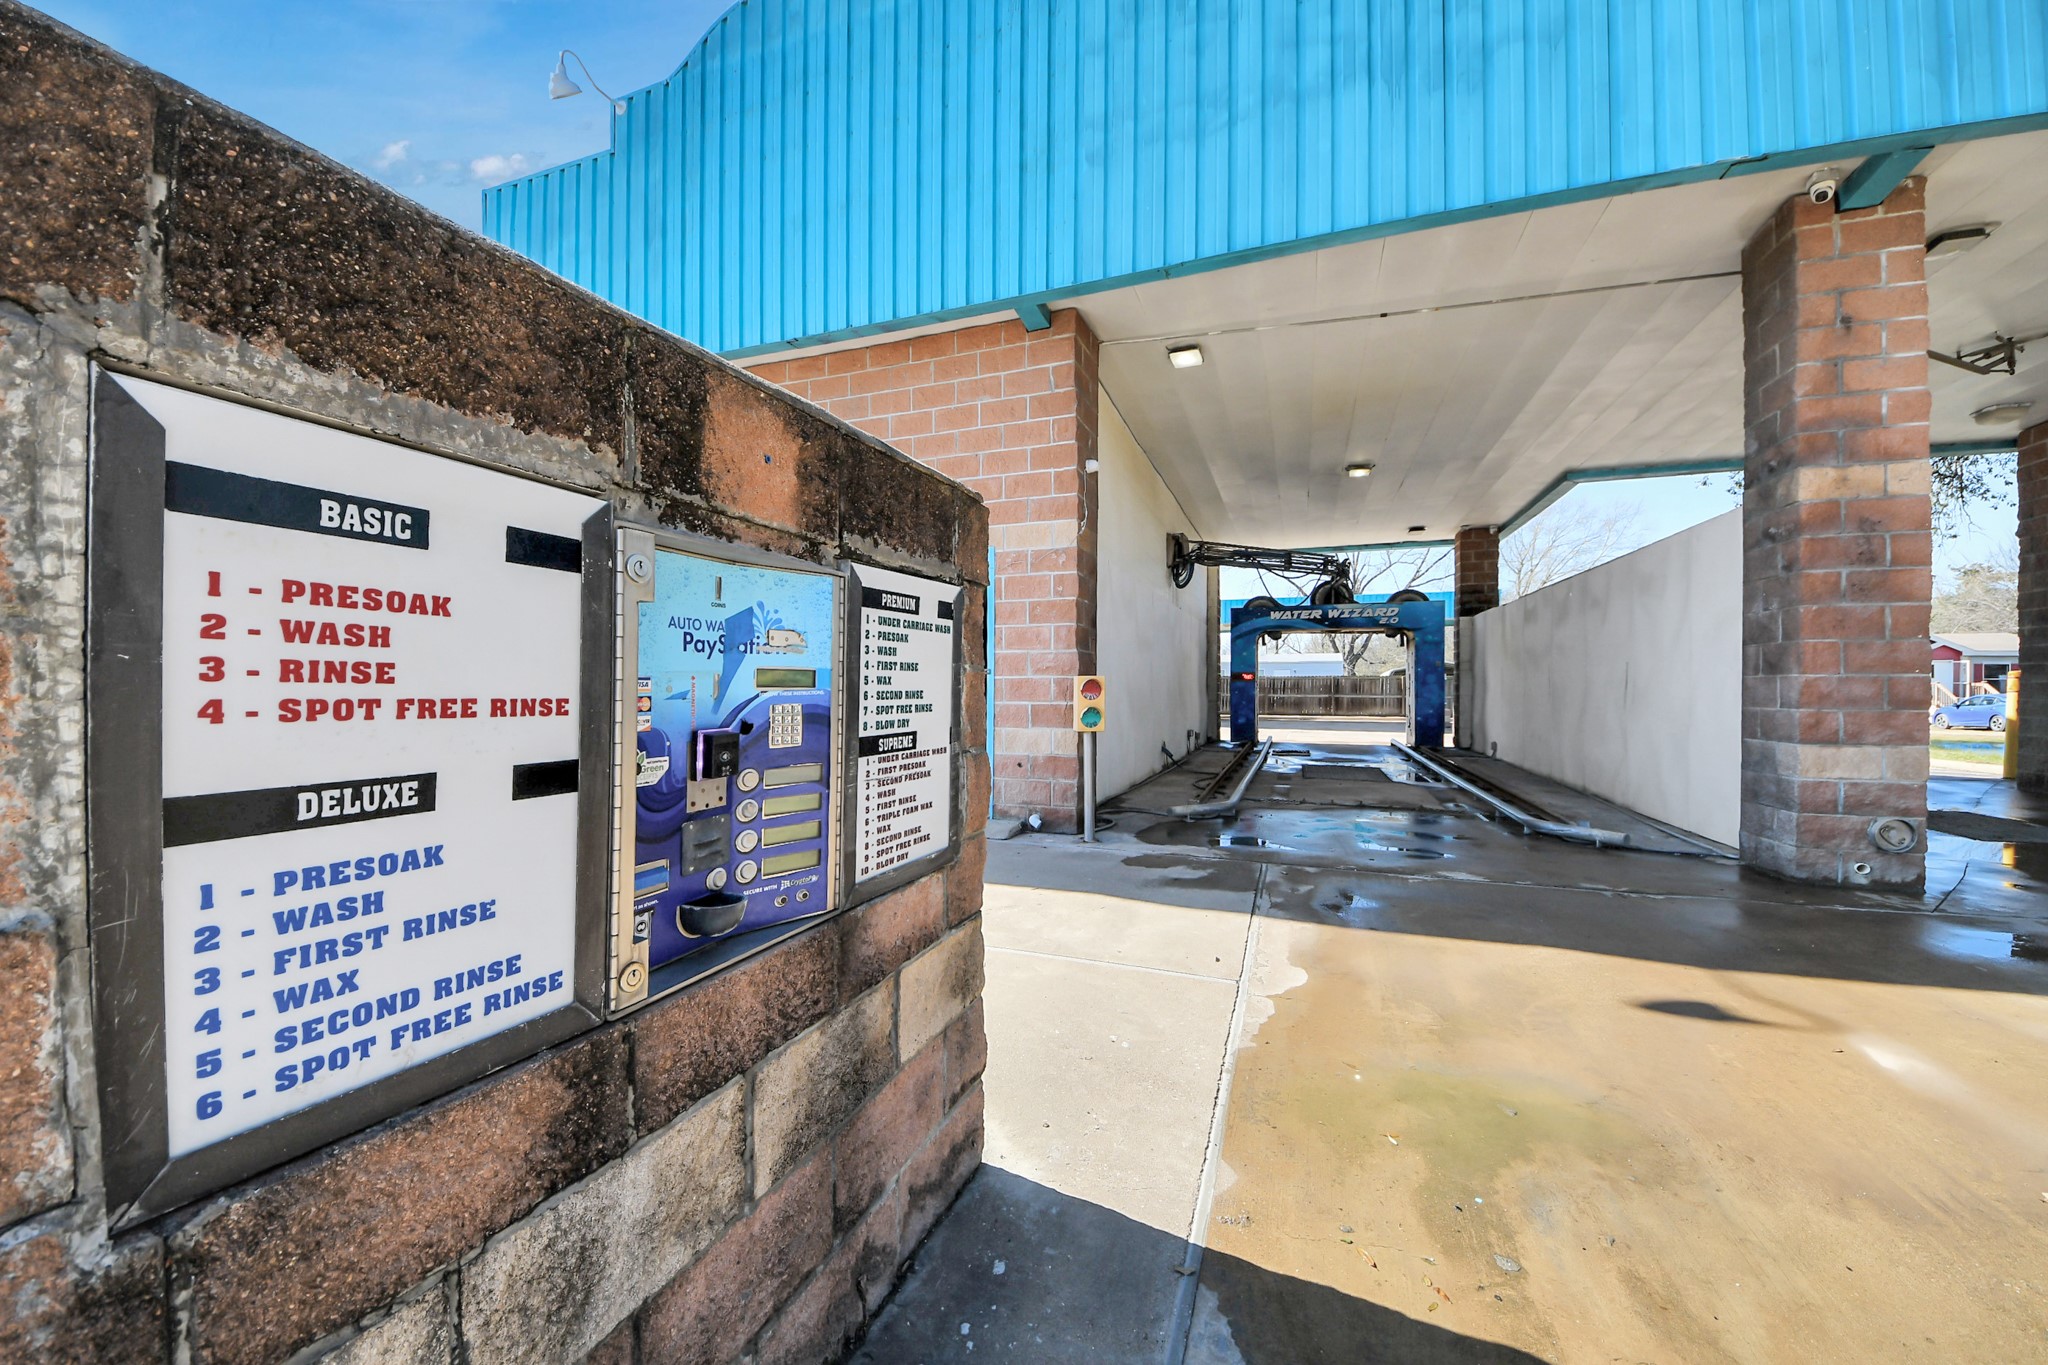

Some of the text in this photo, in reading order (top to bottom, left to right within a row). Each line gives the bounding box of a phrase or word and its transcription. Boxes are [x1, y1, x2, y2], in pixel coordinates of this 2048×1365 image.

[320, 499, 411, 539] BASIC
[207, 571, 221, 597] 1
[281, 579, 451, 617] PRESOAK
[882, 594, 915, 610] PREMIUM
[1270, 608, 1399, 620] WATER WIZARD
[200, 614, 227, 640] 2
[279, 619, 391, 648] WASH
[668, 616, 726, 632] AUTO WA
[866, 614, 869, 624] 1
[878, 616, 901, 628] UNDER
[903, 619, 933, 632] CARRIAGE
[935, 624, 950, 634] WASH
[865, 629, 870, 639] 2
[878, 631, 909, 643] PRESOAK
[865, 645, 869, 655] 3
[877, 646, 897, 656] WASH
[199, 656, 225, 682] 3
[279, 659, 395, 684] RINSE
[864, 660, 869, 670] 4
[877, 661, 898, 671] FIRST
[900, 662, 919, 672] RINSE
[864, 675, 869, 685] 5
[876, 676, 892, 685] WAX
[864, 691, 868, 701] 6
[876, 690, 903, 700] SECOND
[905, 690, 924, 699] RINSE
[197, 699, 224, 724] 4
[278, 698, 381, 723] SPOT
[396, 698, 477, 720] FREE
[490, 698, 569, 717] RINSE
[863, 706, 868, 716] 7
[876, 705, 894, 715] SPOT
[896, 704, 913, 714] FREE
[915, 704, 933, 713] RINSE
[863, 721, 868, 731] 8
[875, 720, 895, 730] BLOW
[897, 719, 910, 728] DRY
[879, 735, 913, 751] SUPREME
[867, 758, 869, 766] 1
[878, 754, 899, 764] UNDER
[901, 749, 930, 760] CARRIAGE
[932, 747, 947, 755] WASH
[641, 764, 664, 773] Green
[866, 770, 870, 778] 2
[877, 765, 897, 776] FIRST
[899, 761, 926, 772] PRESOAK
[866, 782, 870, 790] 3
[877, 776, 902, 788] SECOND
[904, 770, 931, 782] PRESOAK
[297, 781, 418, 820] DELUXE
[865, 794, 870, 802] 4
[877, 788, 896, 799] WASH
[865, 806, 870, 814] 5
[877, 799, 896, 811] FIRST
[898, 795, 916, 806] RINSE
[865, 818, 869, 826] 6
[877, 810, 900, 823] TRIPLE
[902, 805, 919, 816] FOAM
[920, 801, 933, 810] WAX
[865, 830, 869, 838] 7
[877, 824, 891, 834] WAX
[865, 842, 869, 850] 8
[876, 832, 902, 846] SECOND
[904, 825, 921, 837] RINSE
[864, 854, 869, 862] 9
[876, 846, 894, 858] SPOT
[896, 840, 911, 851] FREE
[913, 833, 930, 845] RINSE
[861, 866, 869, 876] 10
[876, 857, 895, 870] BLOW
[897, 851, 909, 862] DRY
[200, 884, 214, 910] 1
[274, 845, 444, 896] PRESOAK
[743, 887, 762, 895] SECURE
[194, 925, 220, 954] 2
[272, 890, 384, 935] WASH
[194, 967, 220, 995] 3
[274, 925, 389, 975] FIRST
[403, 899, 496, 942] RINSE
[194, 1008, 222, 1035] 4
[273, 969, 359, 1014] WAX
[196, 1048, 222, 1079] 5
[274, 987, 420, 1054] SECOND
[434, 954, 521, 1001] RINSE
[196, 1091, 223, 1120] 6
[275, 1036, 376, 1092] SPOT
[391, 1002, 471, 1050] FREE
[484, 970, 563, 1016] RINSE
